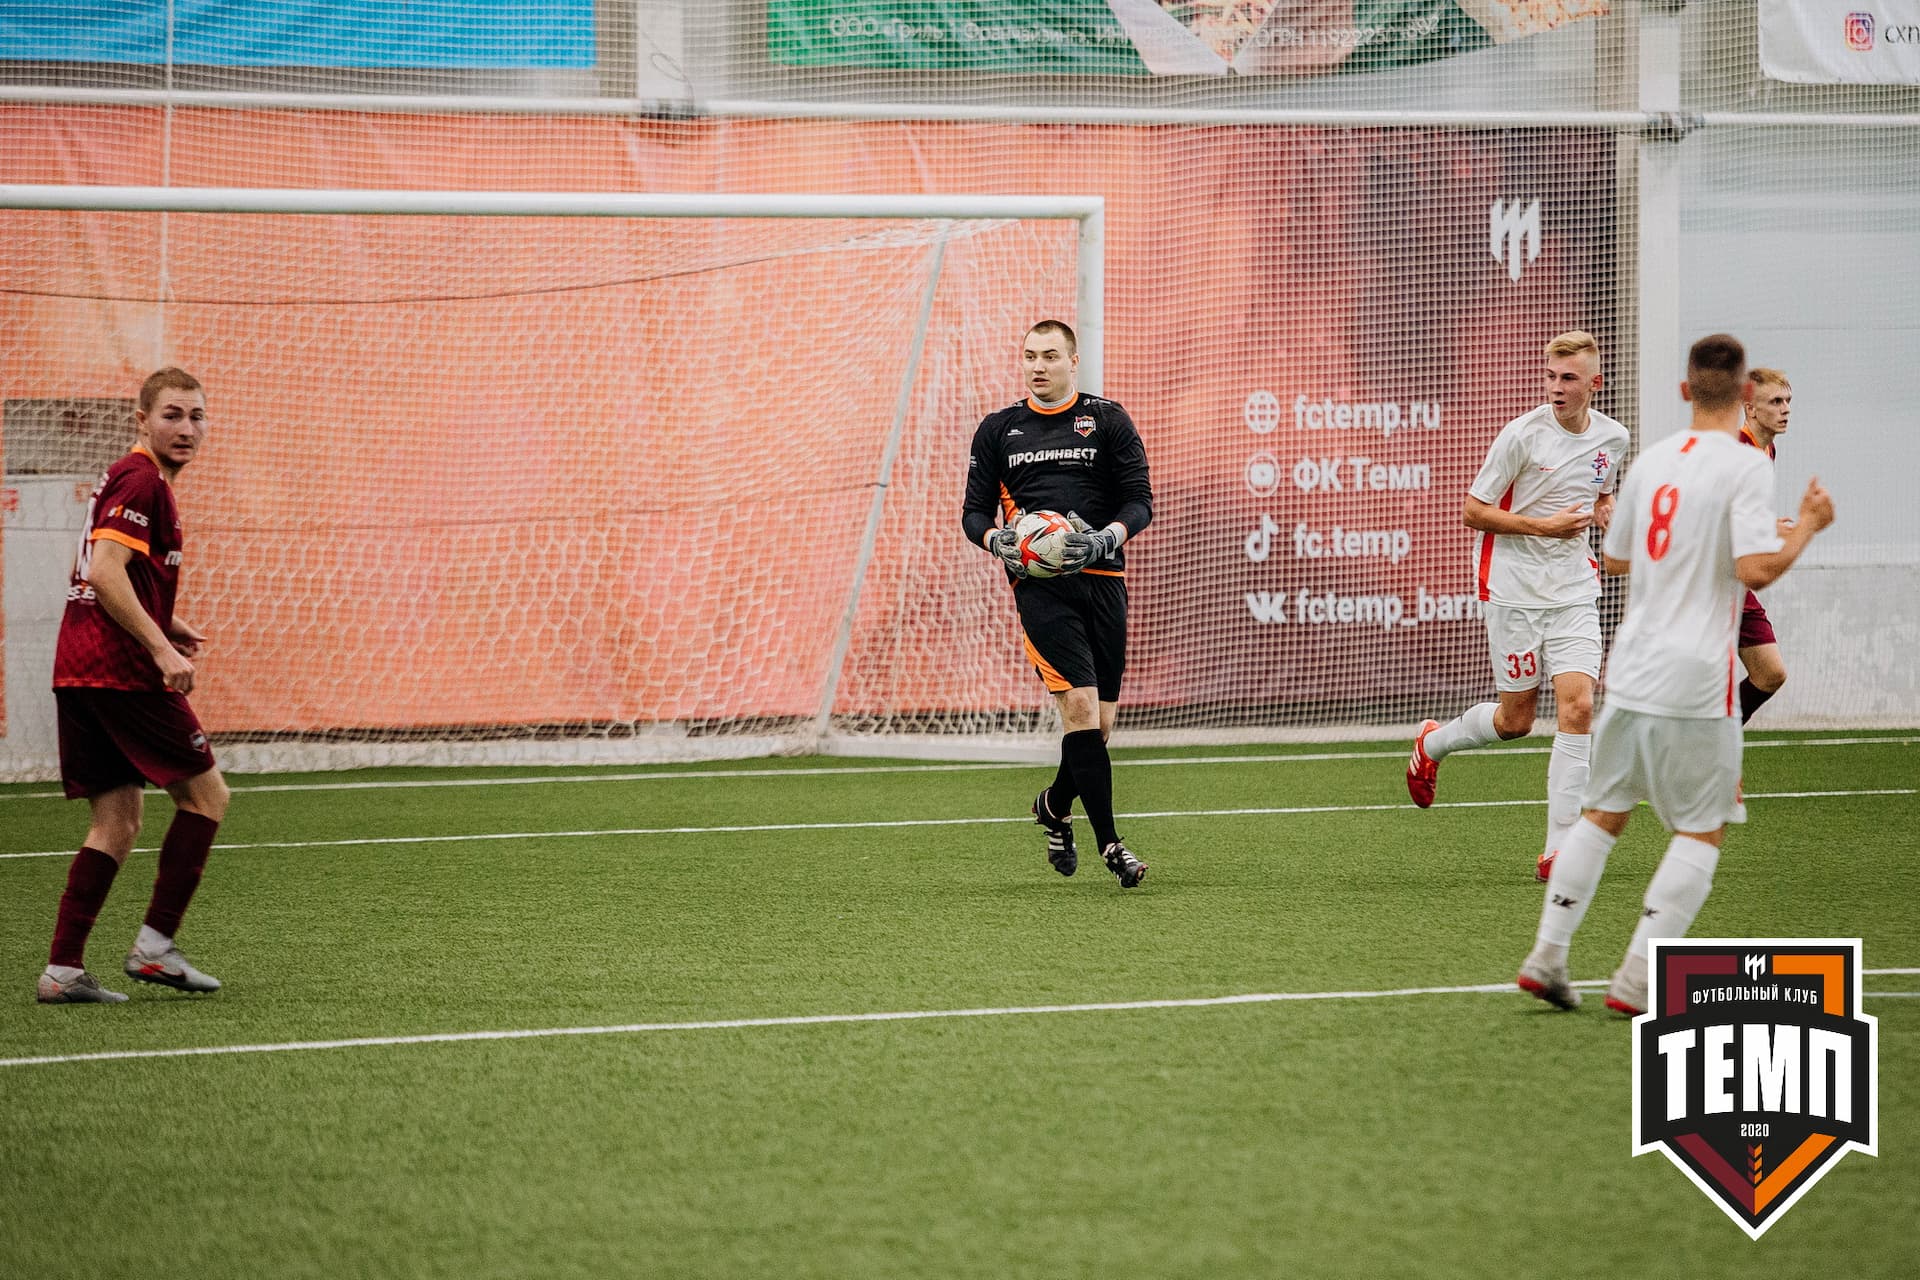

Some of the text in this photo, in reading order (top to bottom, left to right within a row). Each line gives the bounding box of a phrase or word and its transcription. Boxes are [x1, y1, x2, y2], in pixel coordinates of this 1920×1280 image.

[1294, 394, 1442, 437] fctemp.ru
[1008, 447, 1098, 469] ПРОДИНВЕСТ
[1293, 456, 1431, 493] ФК Темп
[1646, 482, 1681, 563] 8
[1294, 523, 1410, 565] fc.temp
[1507, 651, 1537, 680] 33
